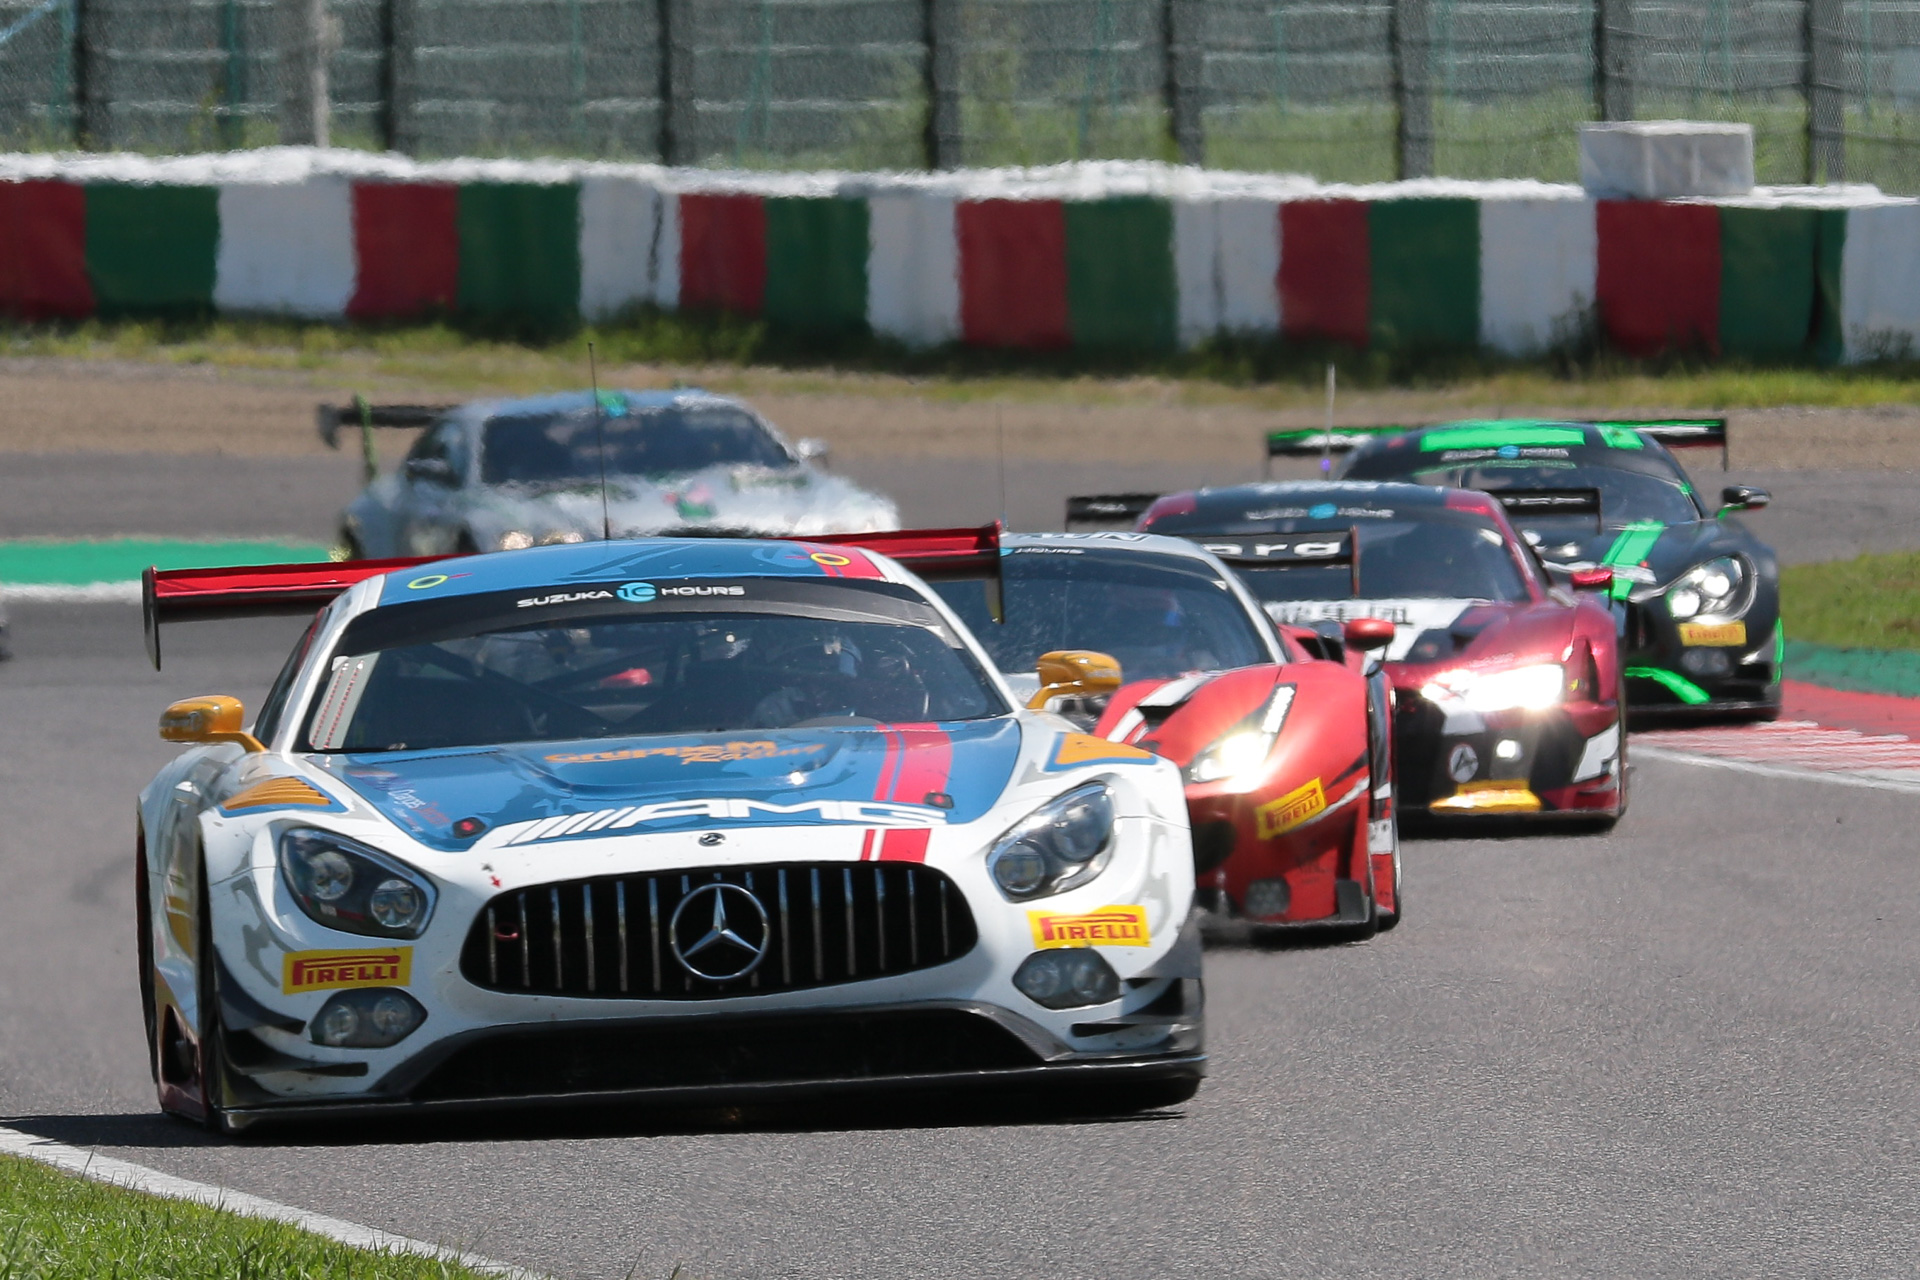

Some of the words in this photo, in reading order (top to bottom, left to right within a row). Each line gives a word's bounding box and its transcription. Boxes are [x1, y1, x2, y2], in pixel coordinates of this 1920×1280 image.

[517, 590, 614, 608] SUZUKA
[661, 585, 746, 597] HOURS
[607, 798, 949, 829] AMG
[1265, 788, 1320, 831] PIRELLI
[1039, 913, 1142, 941] PIRELLI
[292, 955, 401, 986] PIRELLI
